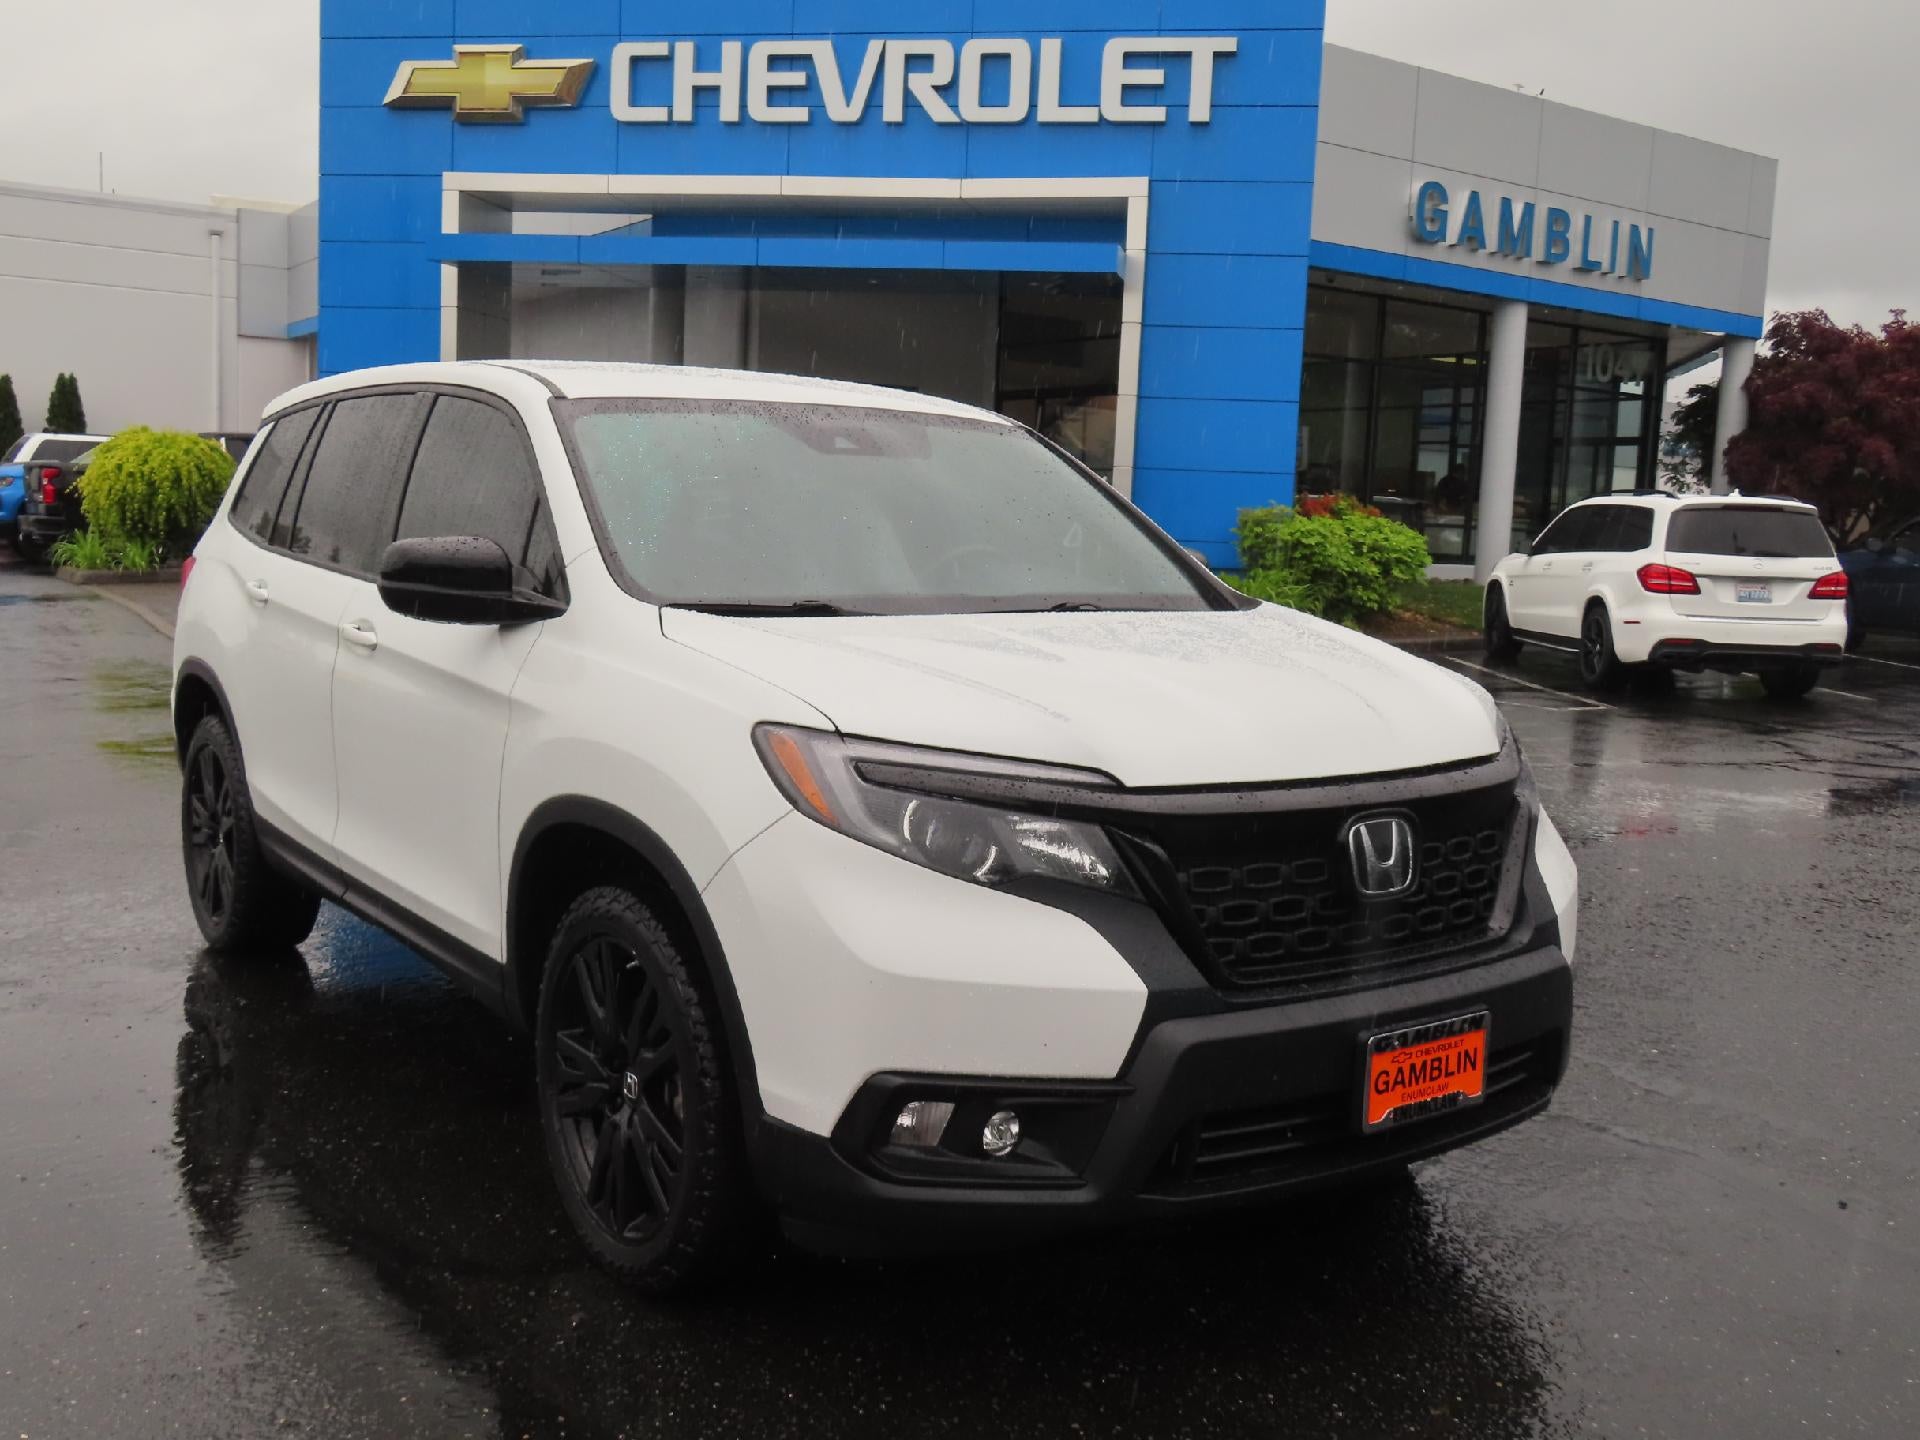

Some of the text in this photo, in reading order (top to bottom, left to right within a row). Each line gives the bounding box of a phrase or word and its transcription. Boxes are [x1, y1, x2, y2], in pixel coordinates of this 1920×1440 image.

[610, 37, 1238, 124] CHEVROLET
[1416, 181, 1654, 280] GAMBLIN
[1374, 1047, 1478, 1096] GAMBLIN
[1415, 1040, 1464, 1058] CHEVROLET
